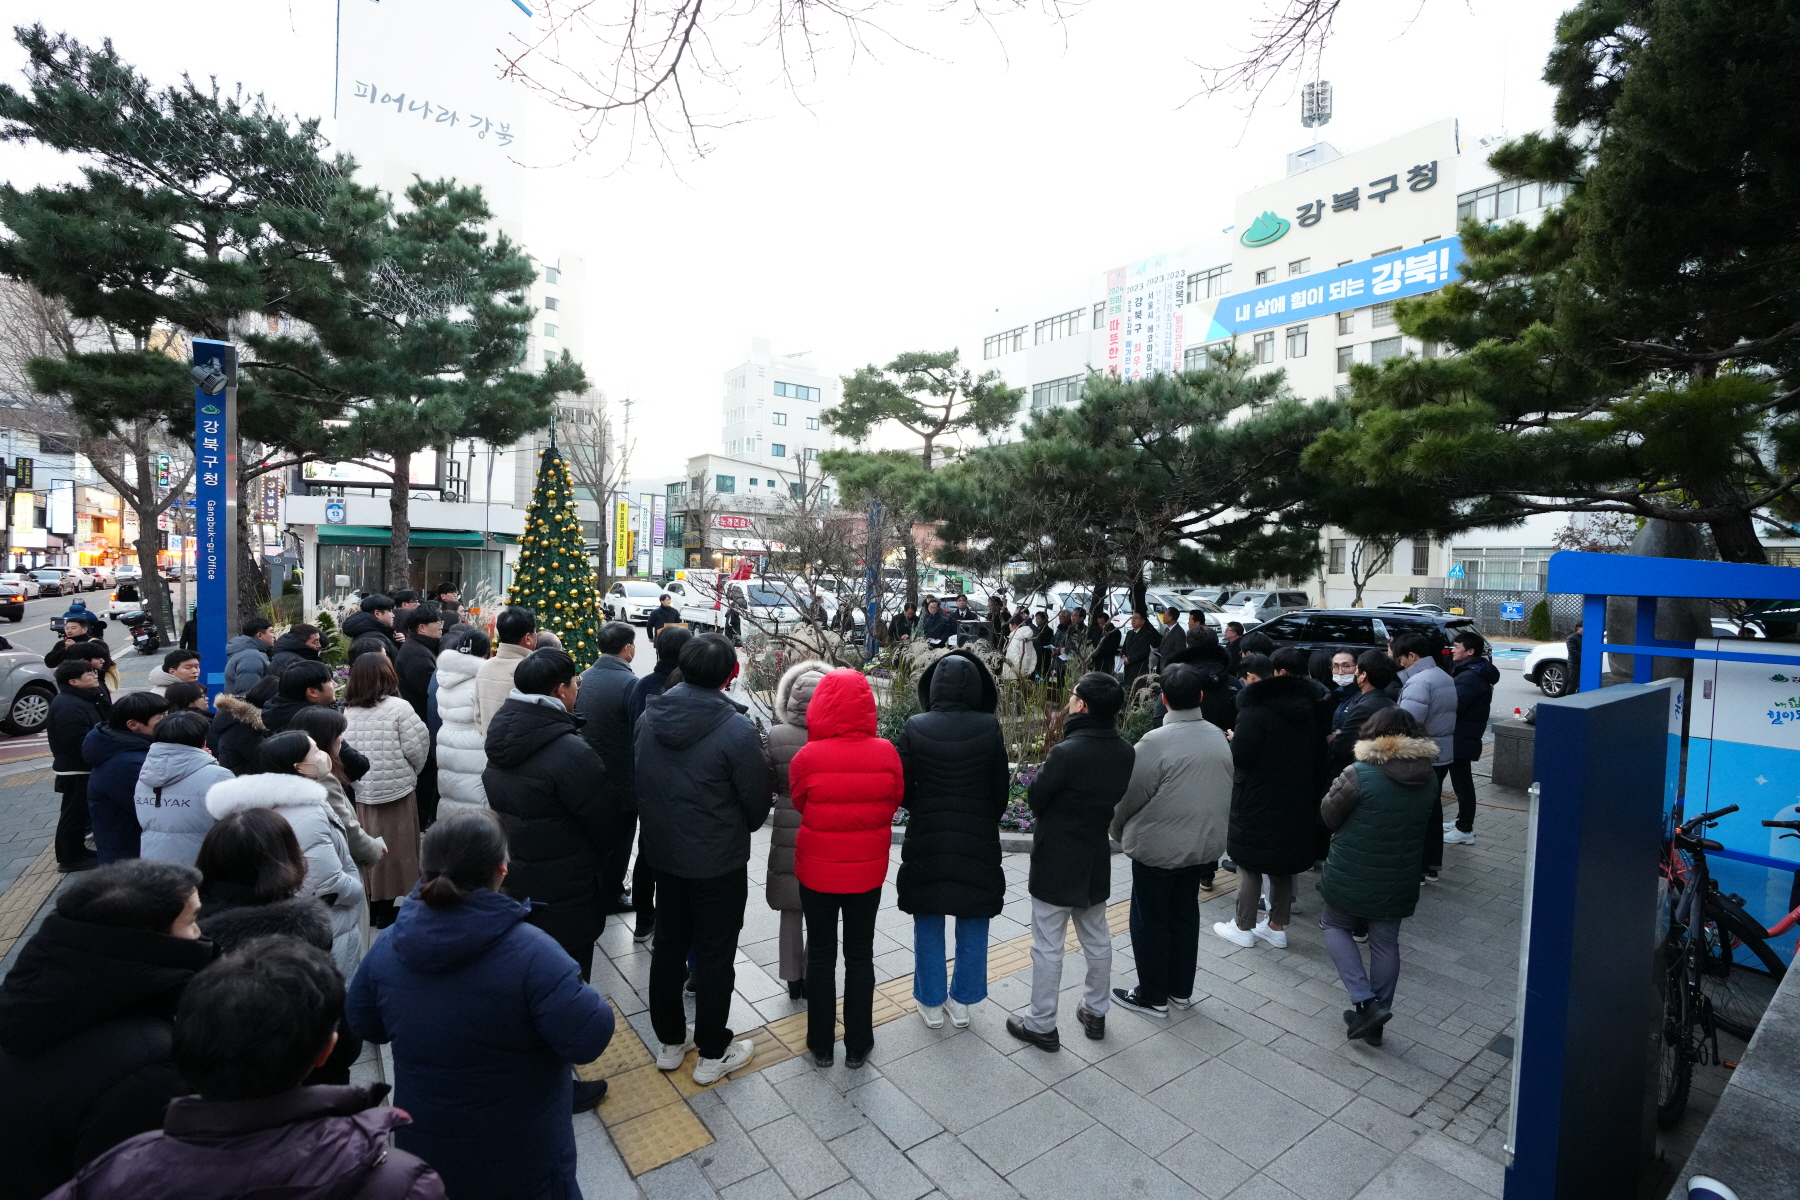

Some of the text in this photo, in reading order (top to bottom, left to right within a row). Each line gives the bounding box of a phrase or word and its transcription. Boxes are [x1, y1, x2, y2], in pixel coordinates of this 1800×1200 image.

[353, 80, 515, 147] 피어나라 강북
[1296, 160, 1438, 228] 강북구청
[1134, 297, 1143, 334] 강북구
[1175, 280, 1185, 309] 강북구
[1235, 246, 1450, 323] 내 삶에 힘이 되는 강북!
[202, 420, 220, 487] 강북구청
[206, 500, 217, 580] Gangbuk-gu Office
[136, 797, 191, 807] BLAC YAK
